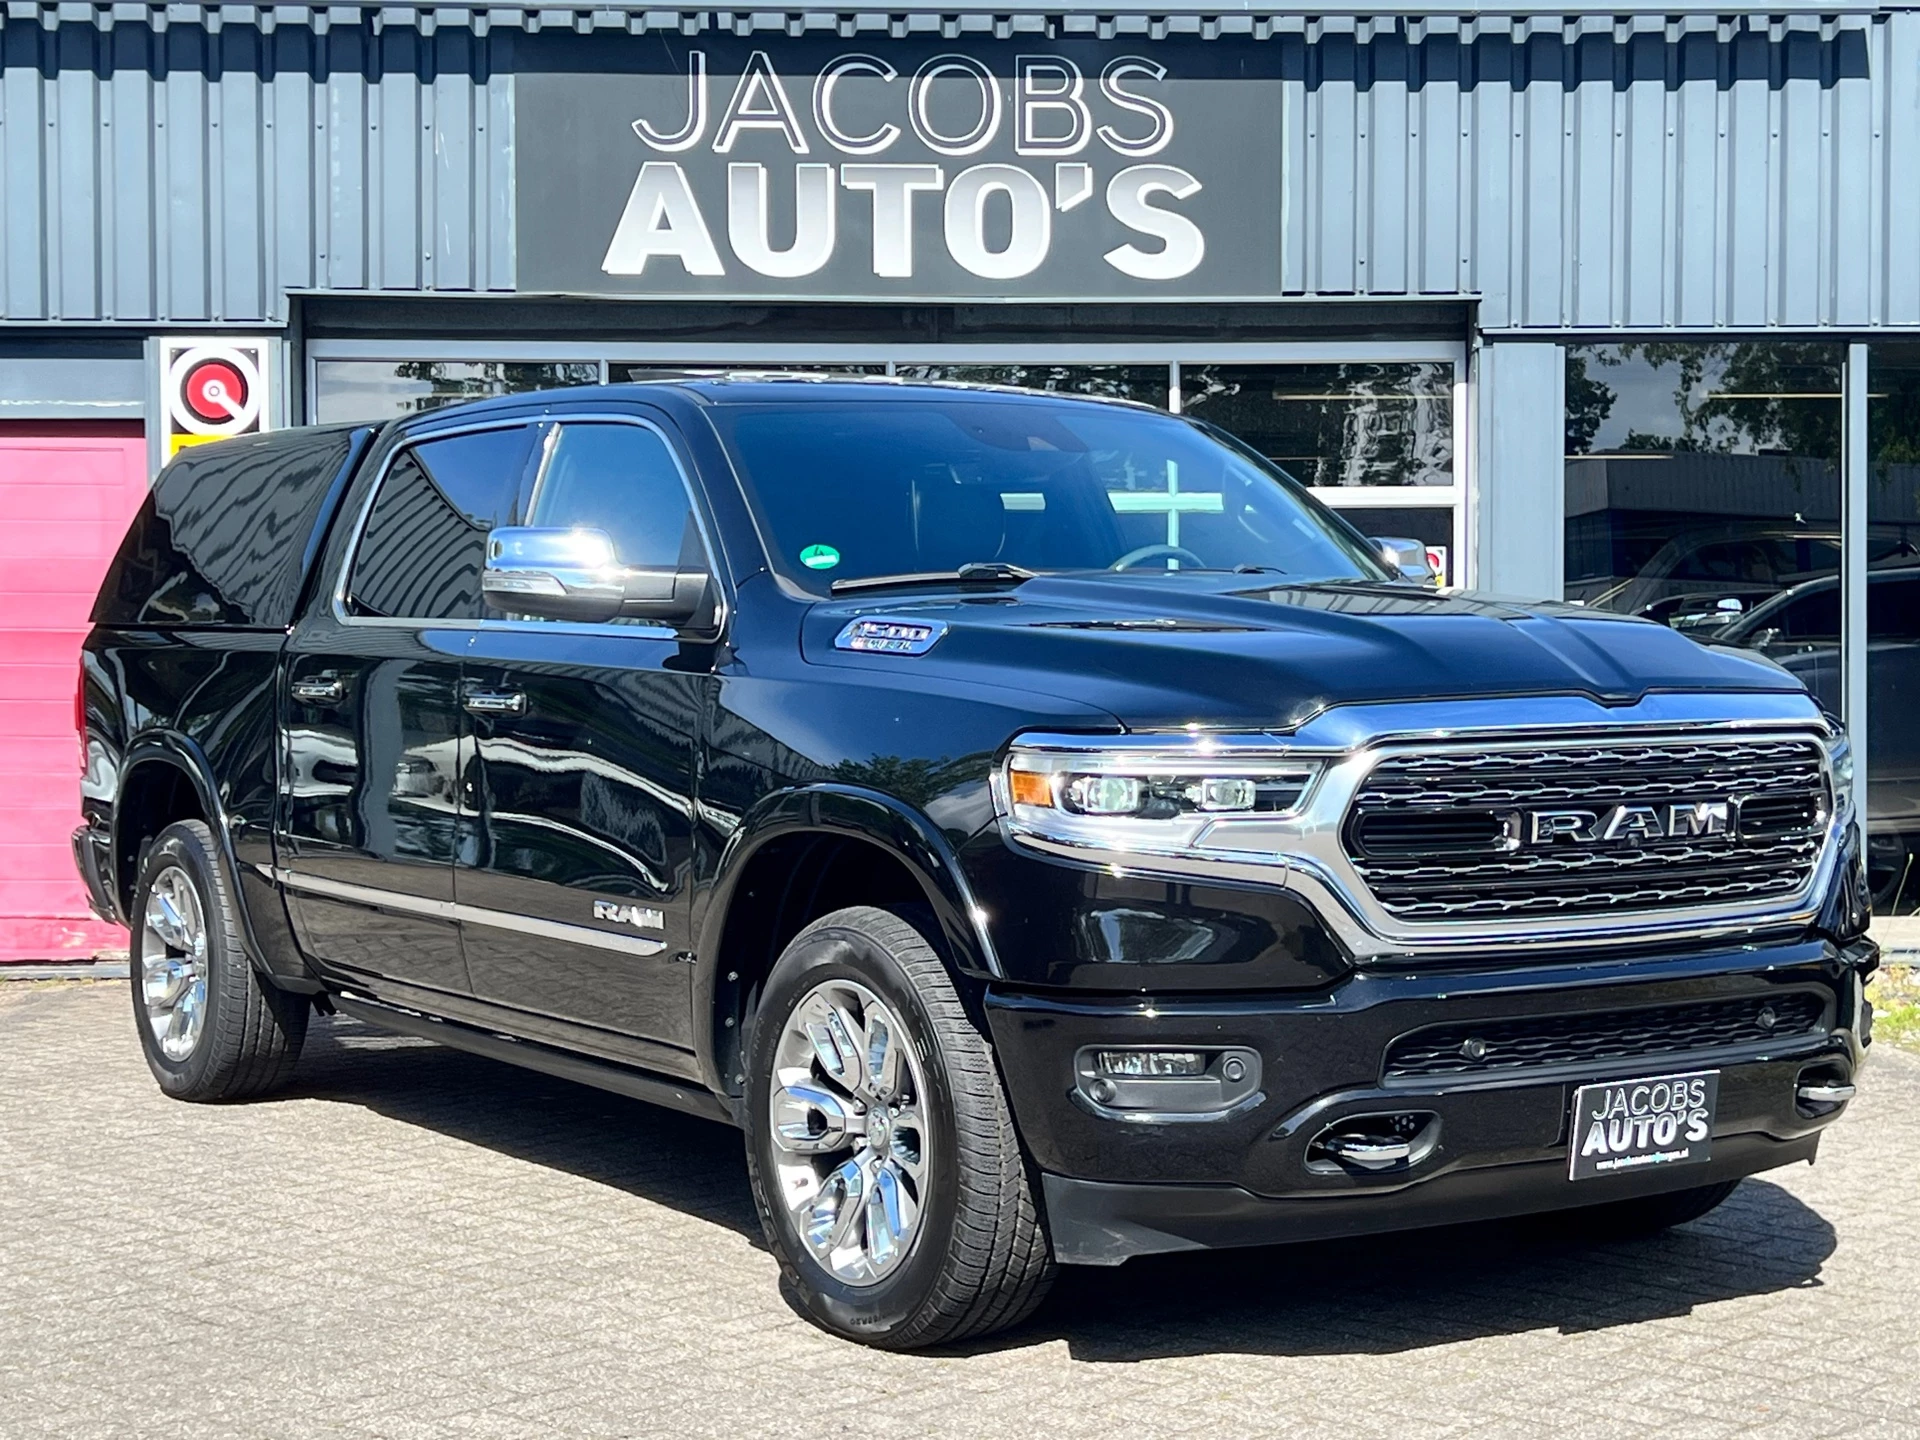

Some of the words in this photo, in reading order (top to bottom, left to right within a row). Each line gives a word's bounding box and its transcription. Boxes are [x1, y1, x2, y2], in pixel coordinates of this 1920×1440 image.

[632, 51, 1174, 157] JACOBS
[601, 161, 1205, 280] AUTO'S
[1531, 803, 1728, 844] RAM
[593, 900, 665, 930] RAM
[1591, 1078, 1706, 1121] JACOBS
[1580, 1107, 1710, 1158] AUTO'S
